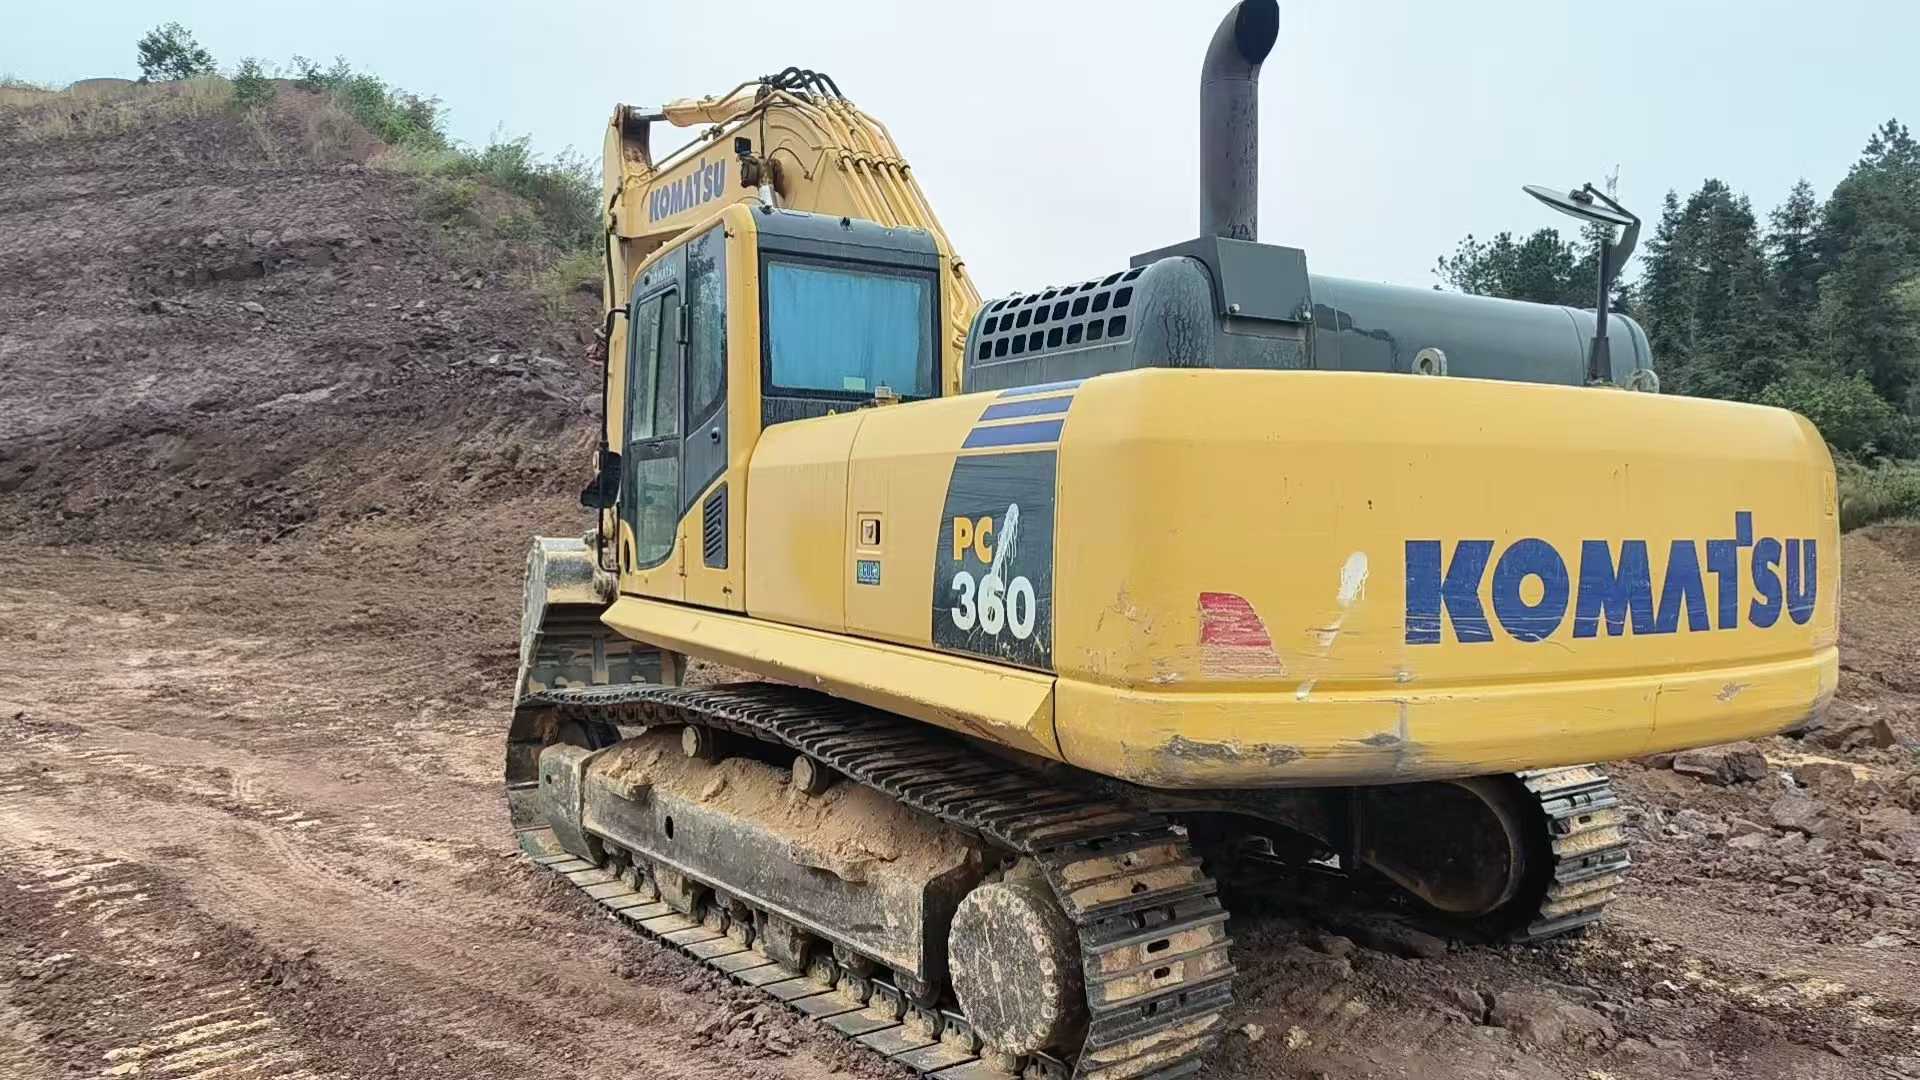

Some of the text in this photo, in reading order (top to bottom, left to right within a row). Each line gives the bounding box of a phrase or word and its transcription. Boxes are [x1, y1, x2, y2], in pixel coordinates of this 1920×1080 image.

[649, 157, 726, 223] KOMATSU
[953, 516, 993, 564] PC
[951, 571, 1036, 640] 360
[1405, 511, 1817, 645] KOMATSU
